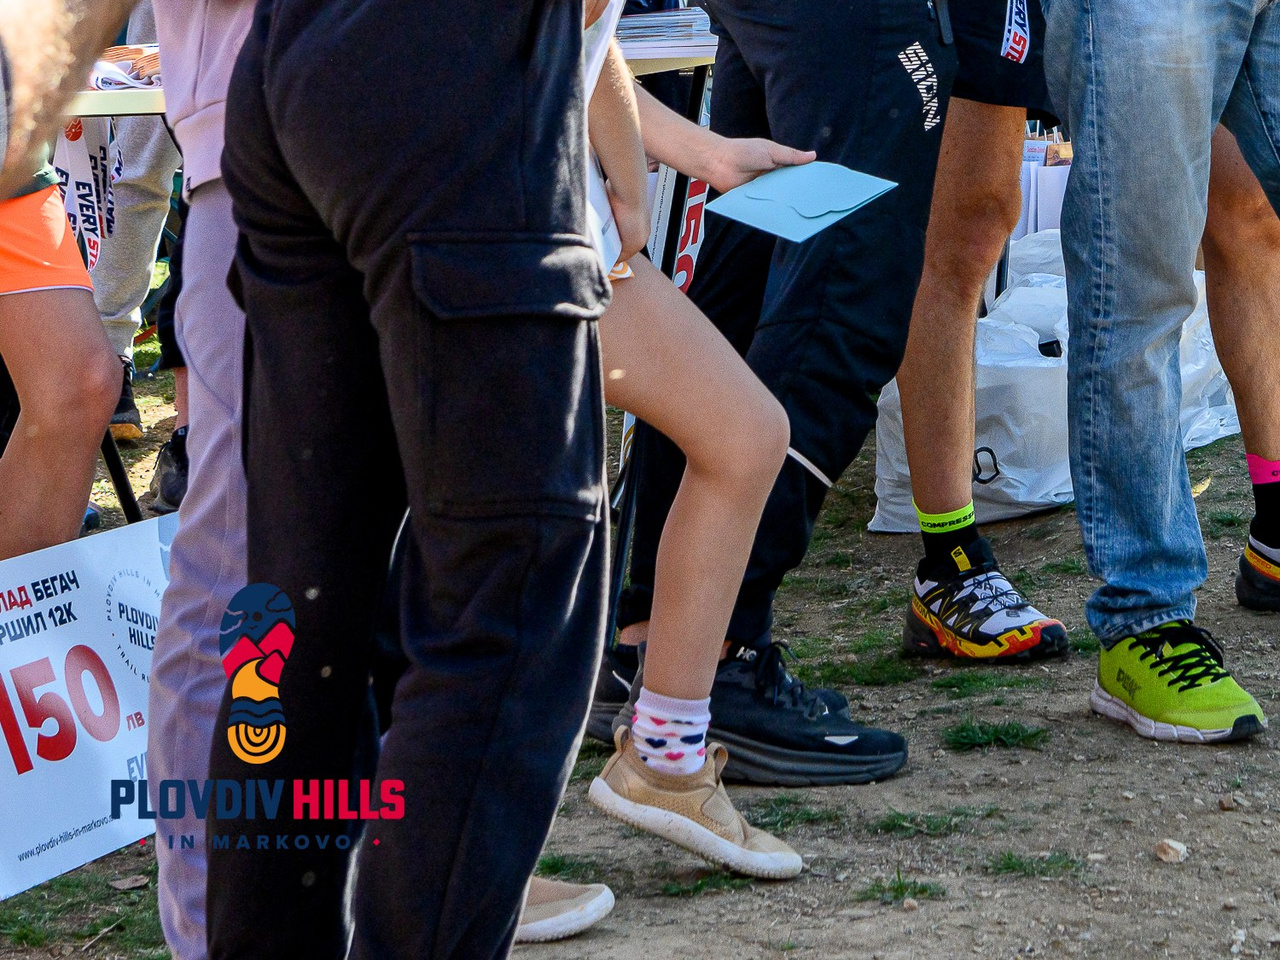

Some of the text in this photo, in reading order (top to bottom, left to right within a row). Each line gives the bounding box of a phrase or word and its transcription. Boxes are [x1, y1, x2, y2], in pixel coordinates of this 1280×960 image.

[1004, 31, 1027, 63] STE
[75, 181, 99, 271] EVERY STE
[31, 570, 80, 602] БЕГАЧ
